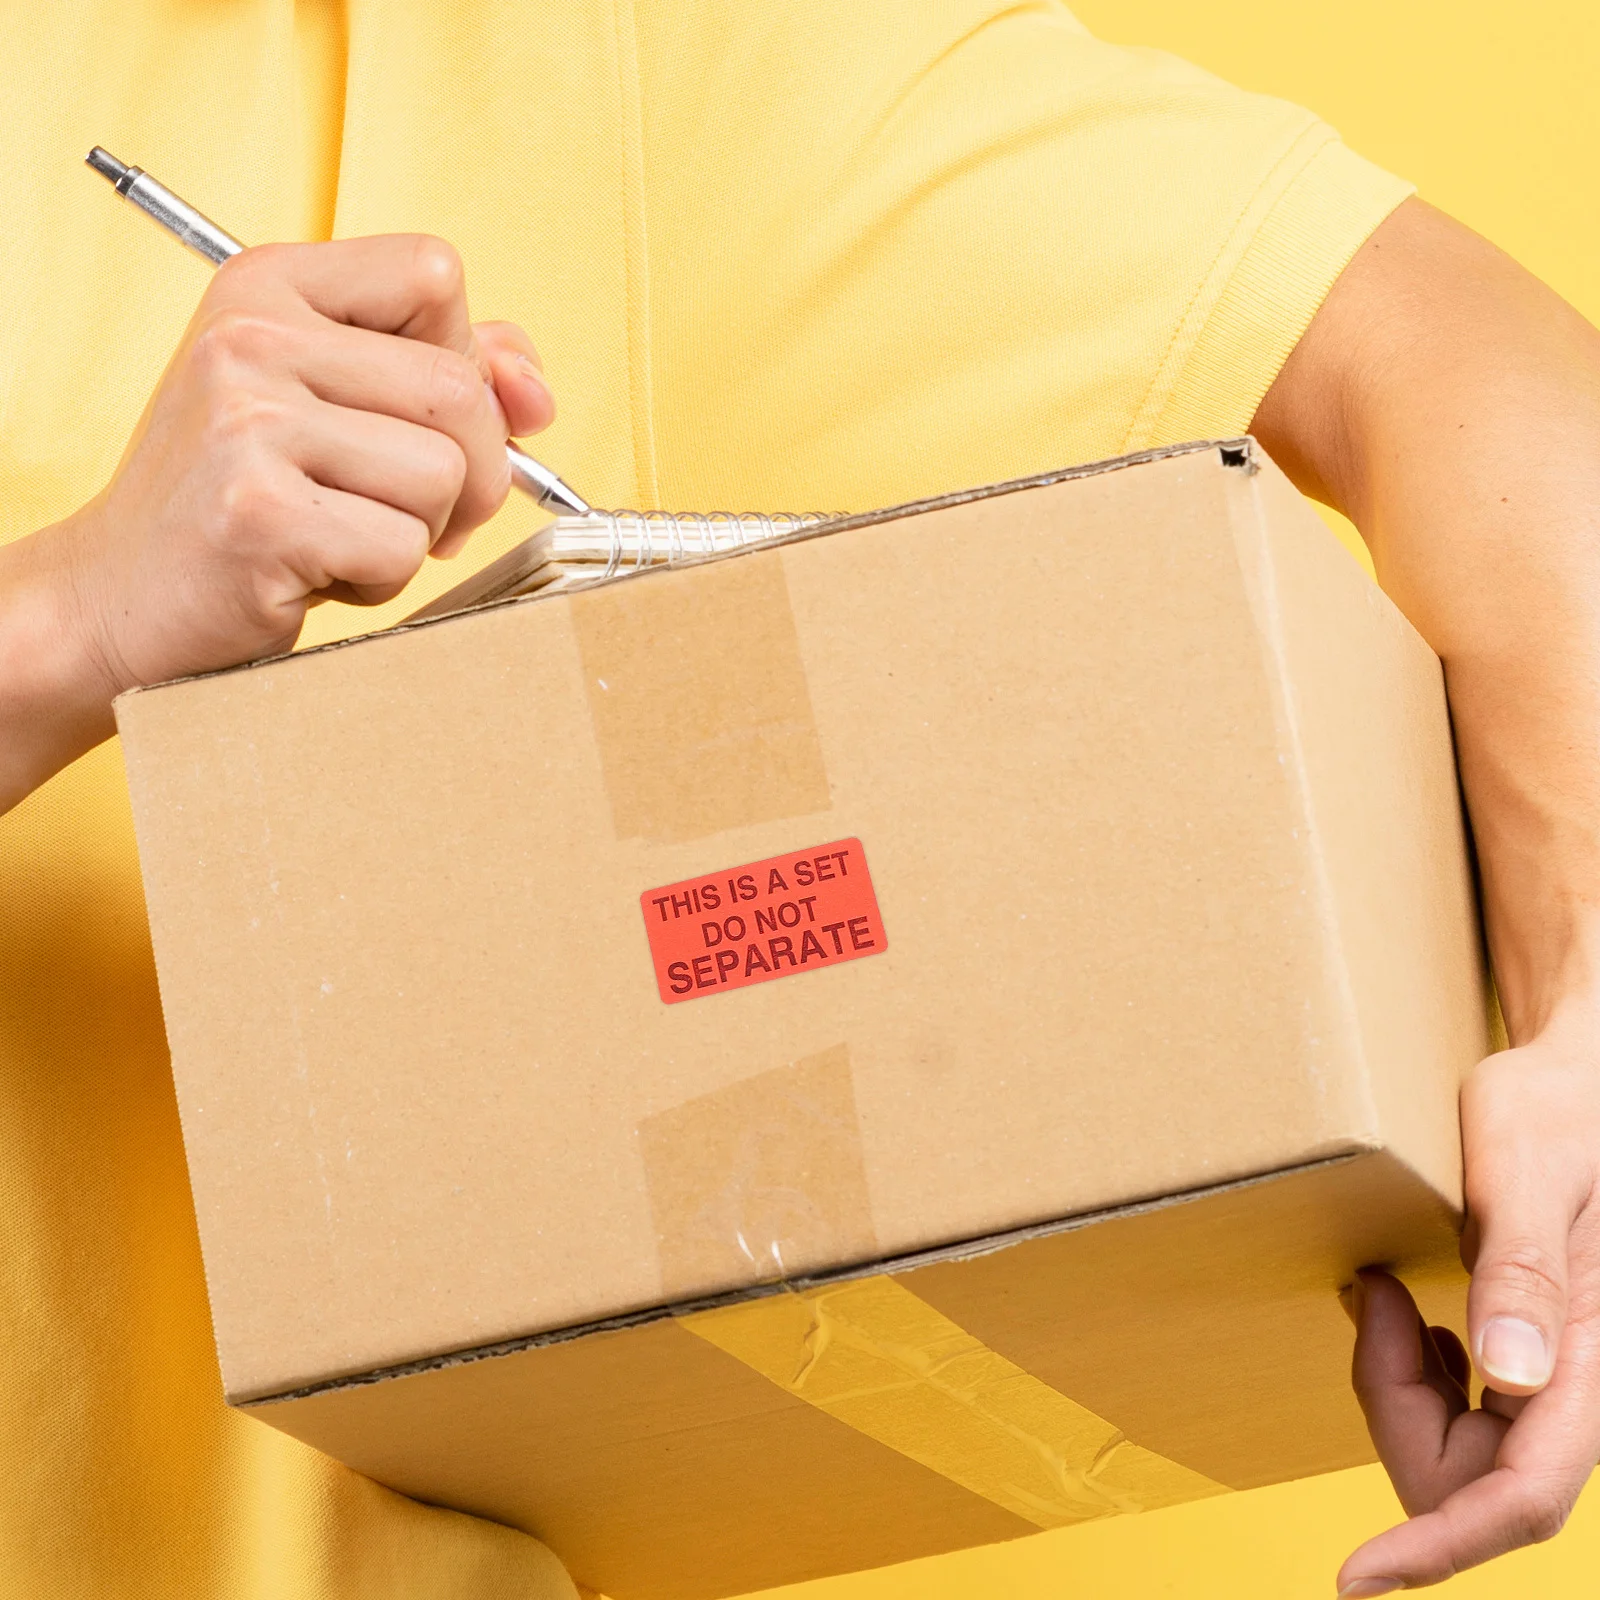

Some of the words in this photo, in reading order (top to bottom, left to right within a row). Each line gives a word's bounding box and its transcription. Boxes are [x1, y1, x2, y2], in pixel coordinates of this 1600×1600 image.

[652, 885, 721, 921] THIS
[728, 875, 758, 903] IS
[768, 868, 789, 894] A
[794, 851, 849, 886] SET
[667, 916, 875, 994] SEPARATE
[702, 916, 746, 947] DO
[754, 896, 817, 934] NOT
